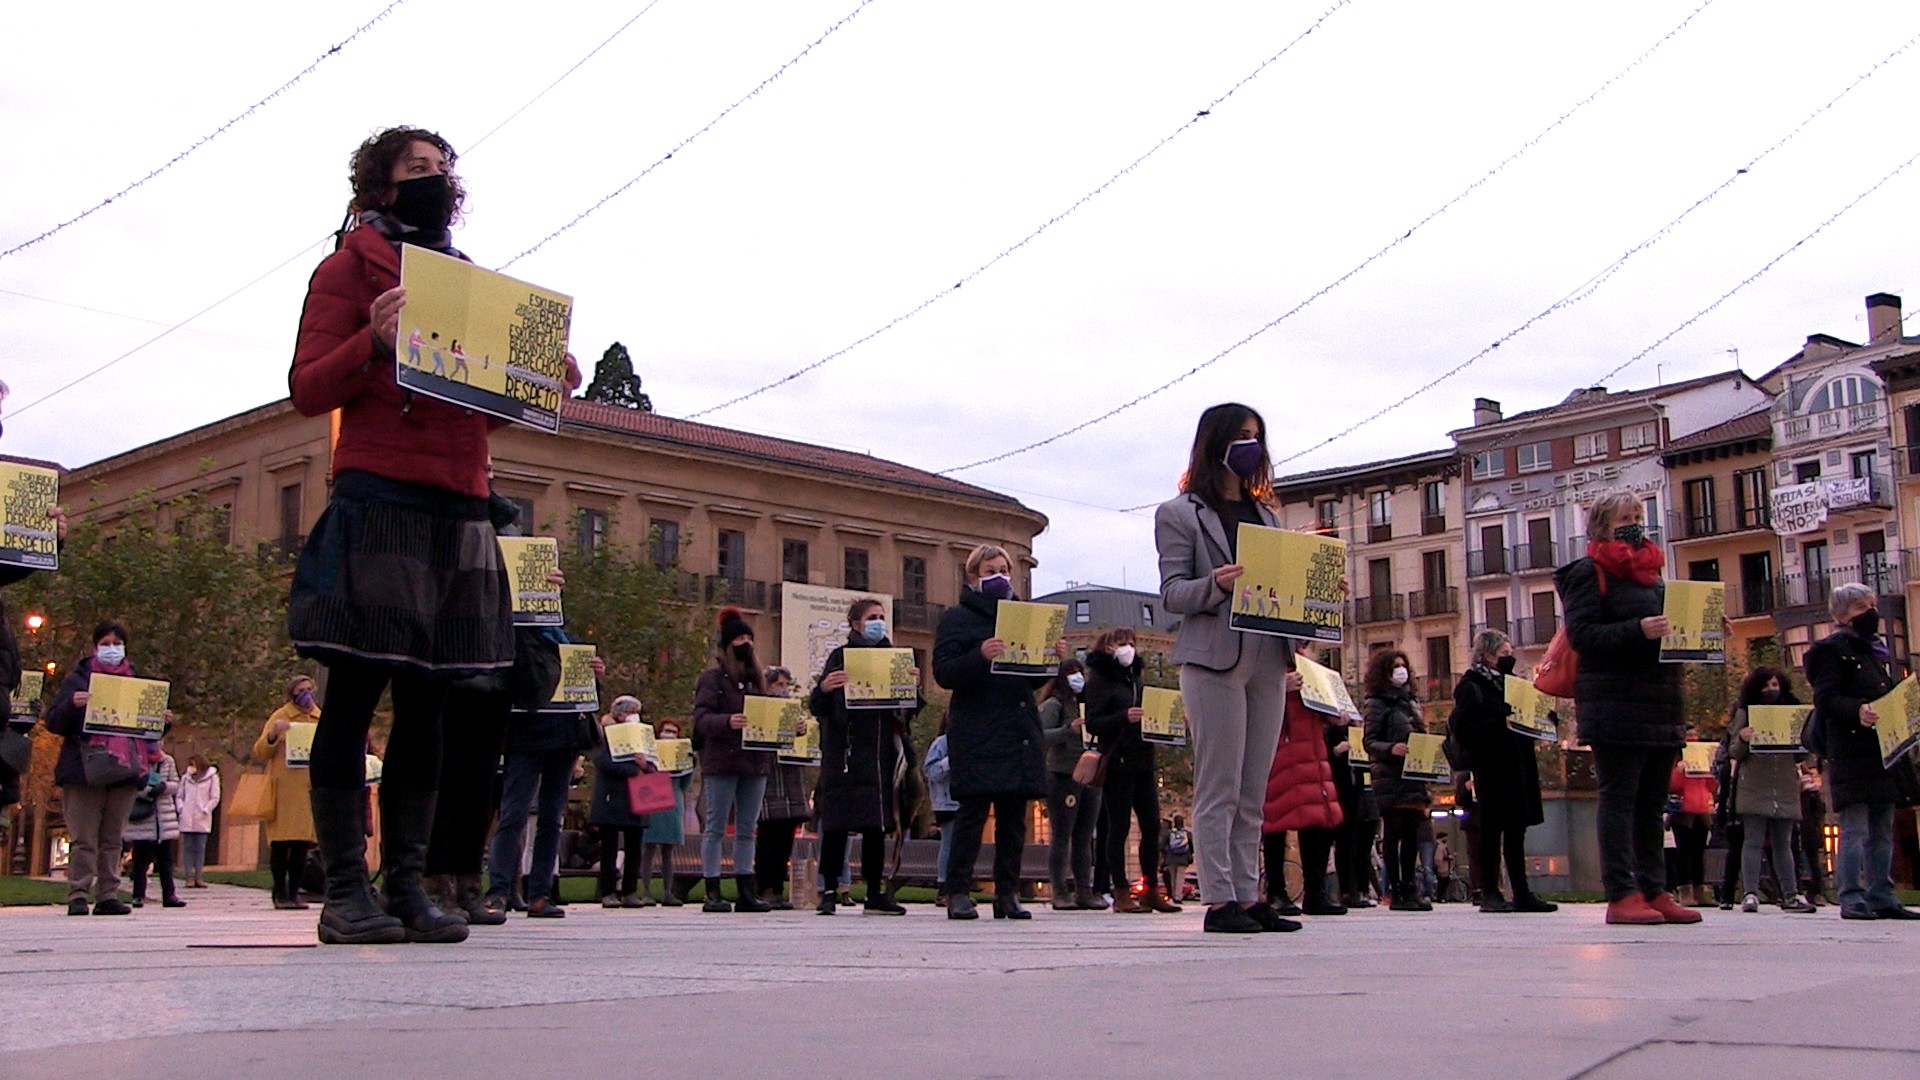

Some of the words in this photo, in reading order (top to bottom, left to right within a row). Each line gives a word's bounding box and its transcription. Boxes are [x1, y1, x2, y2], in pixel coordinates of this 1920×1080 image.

[505, 375, 559, 412] RESPETO
[1509, 480, 1540, 496] EL
[1551, 465, 1618, 489] CISNE
[1523, 494, 1565, 509] HOTEL
[4, 531, 55, 554] RESPETO
[519, 597, 559, 612] RESPETO
[1304, 606, 1341, 627] RESPETO
